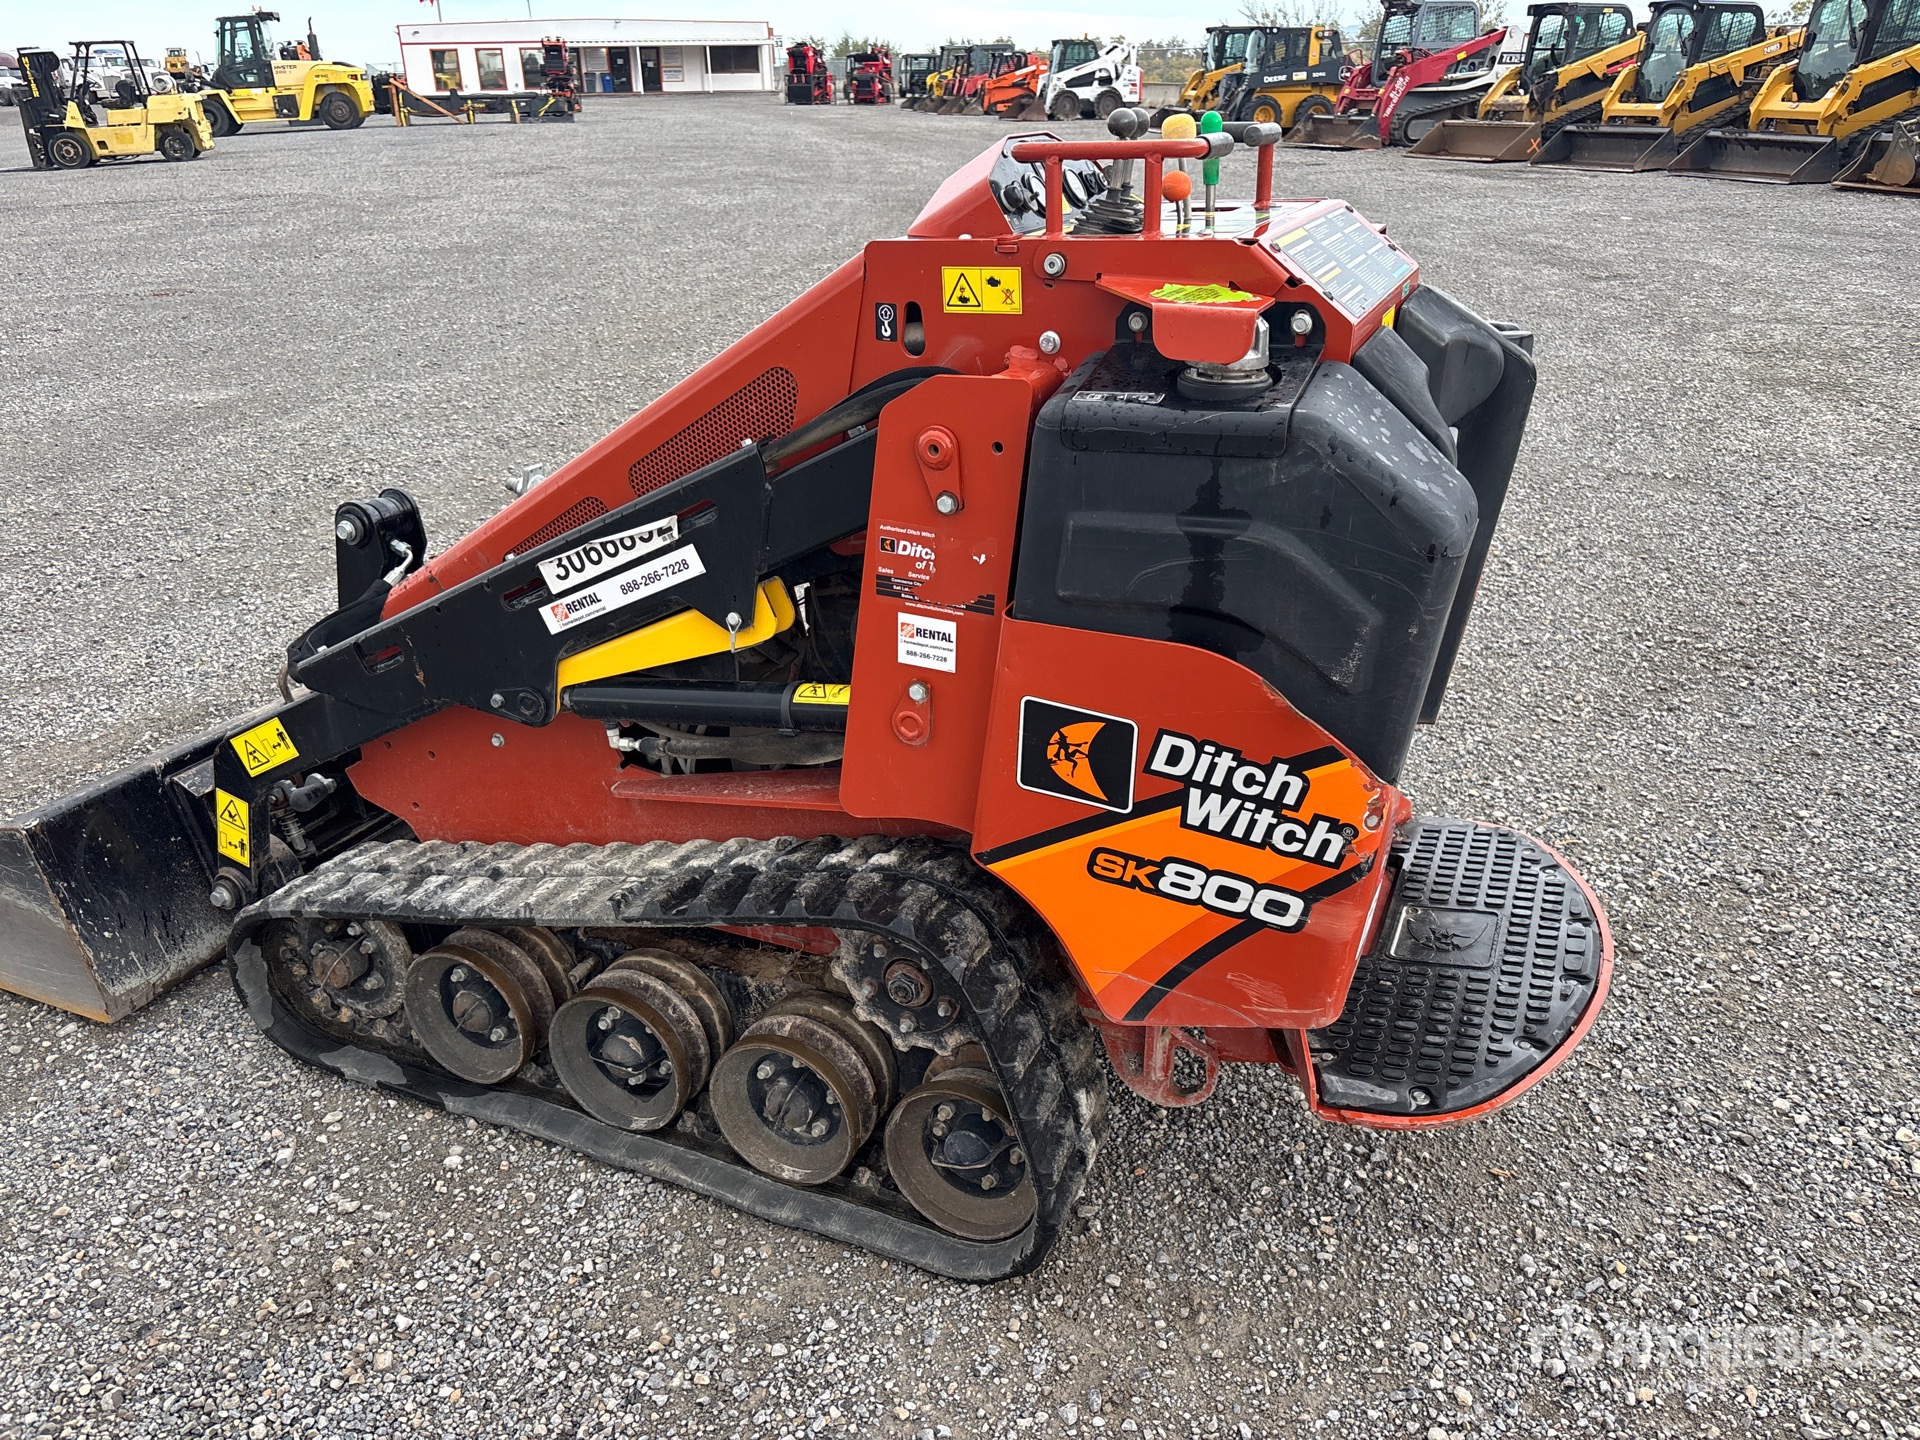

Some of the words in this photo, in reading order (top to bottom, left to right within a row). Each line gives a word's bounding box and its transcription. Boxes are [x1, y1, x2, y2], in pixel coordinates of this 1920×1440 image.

[1263, 74, 1288, 83] DEERE
[906, 528, 921, 536] Ditch
[877, 565, 894, 575] Sales
[907, 570, 931, 581] Service
[915, 560, 927, 570] of
[619, 558, 690, 596] 888-266-7228
[565, 592, 602, 614] RENTAL
[561, 605, 607, 628] homedepot.com/rental
[915, 626, 954, 644] RENTAL
[903, 639, 954, 653] homedepot.com/rental
[905, 649, 948, 663] 888-266-7228
[1150, 733, 1304, 806] Ditch
